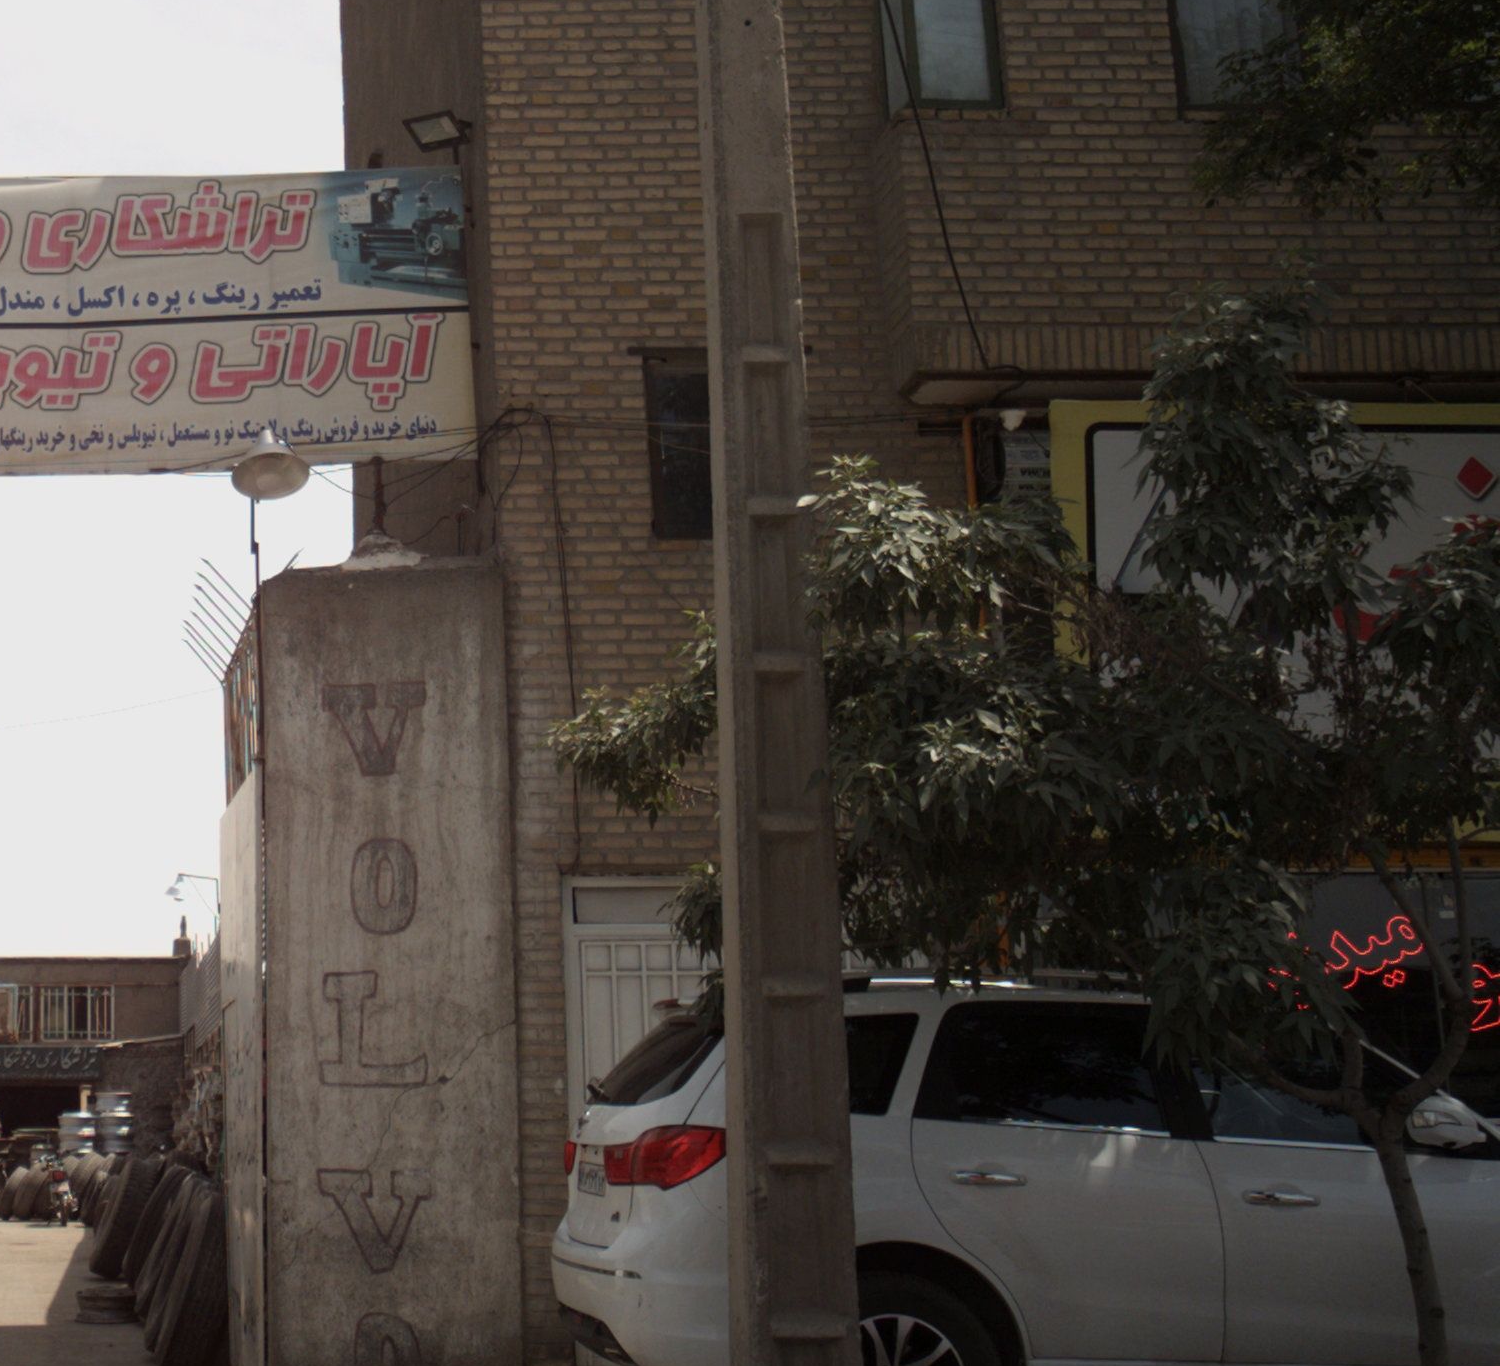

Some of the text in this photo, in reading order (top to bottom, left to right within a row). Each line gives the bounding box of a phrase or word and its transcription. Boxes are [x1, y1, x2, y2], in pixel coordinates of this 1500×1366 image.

[21, 179, 317, 273] تراشکاری
[67, 285, 124, 316] اکسل
[202, 282, 259, 311] رینگ
[266, 278, 322, 310] تعمیر
[130, 342, 177, 404] و
[189, 312, 445, 412] آپاراتی
[237, 418, 278, 443] لاتیک
